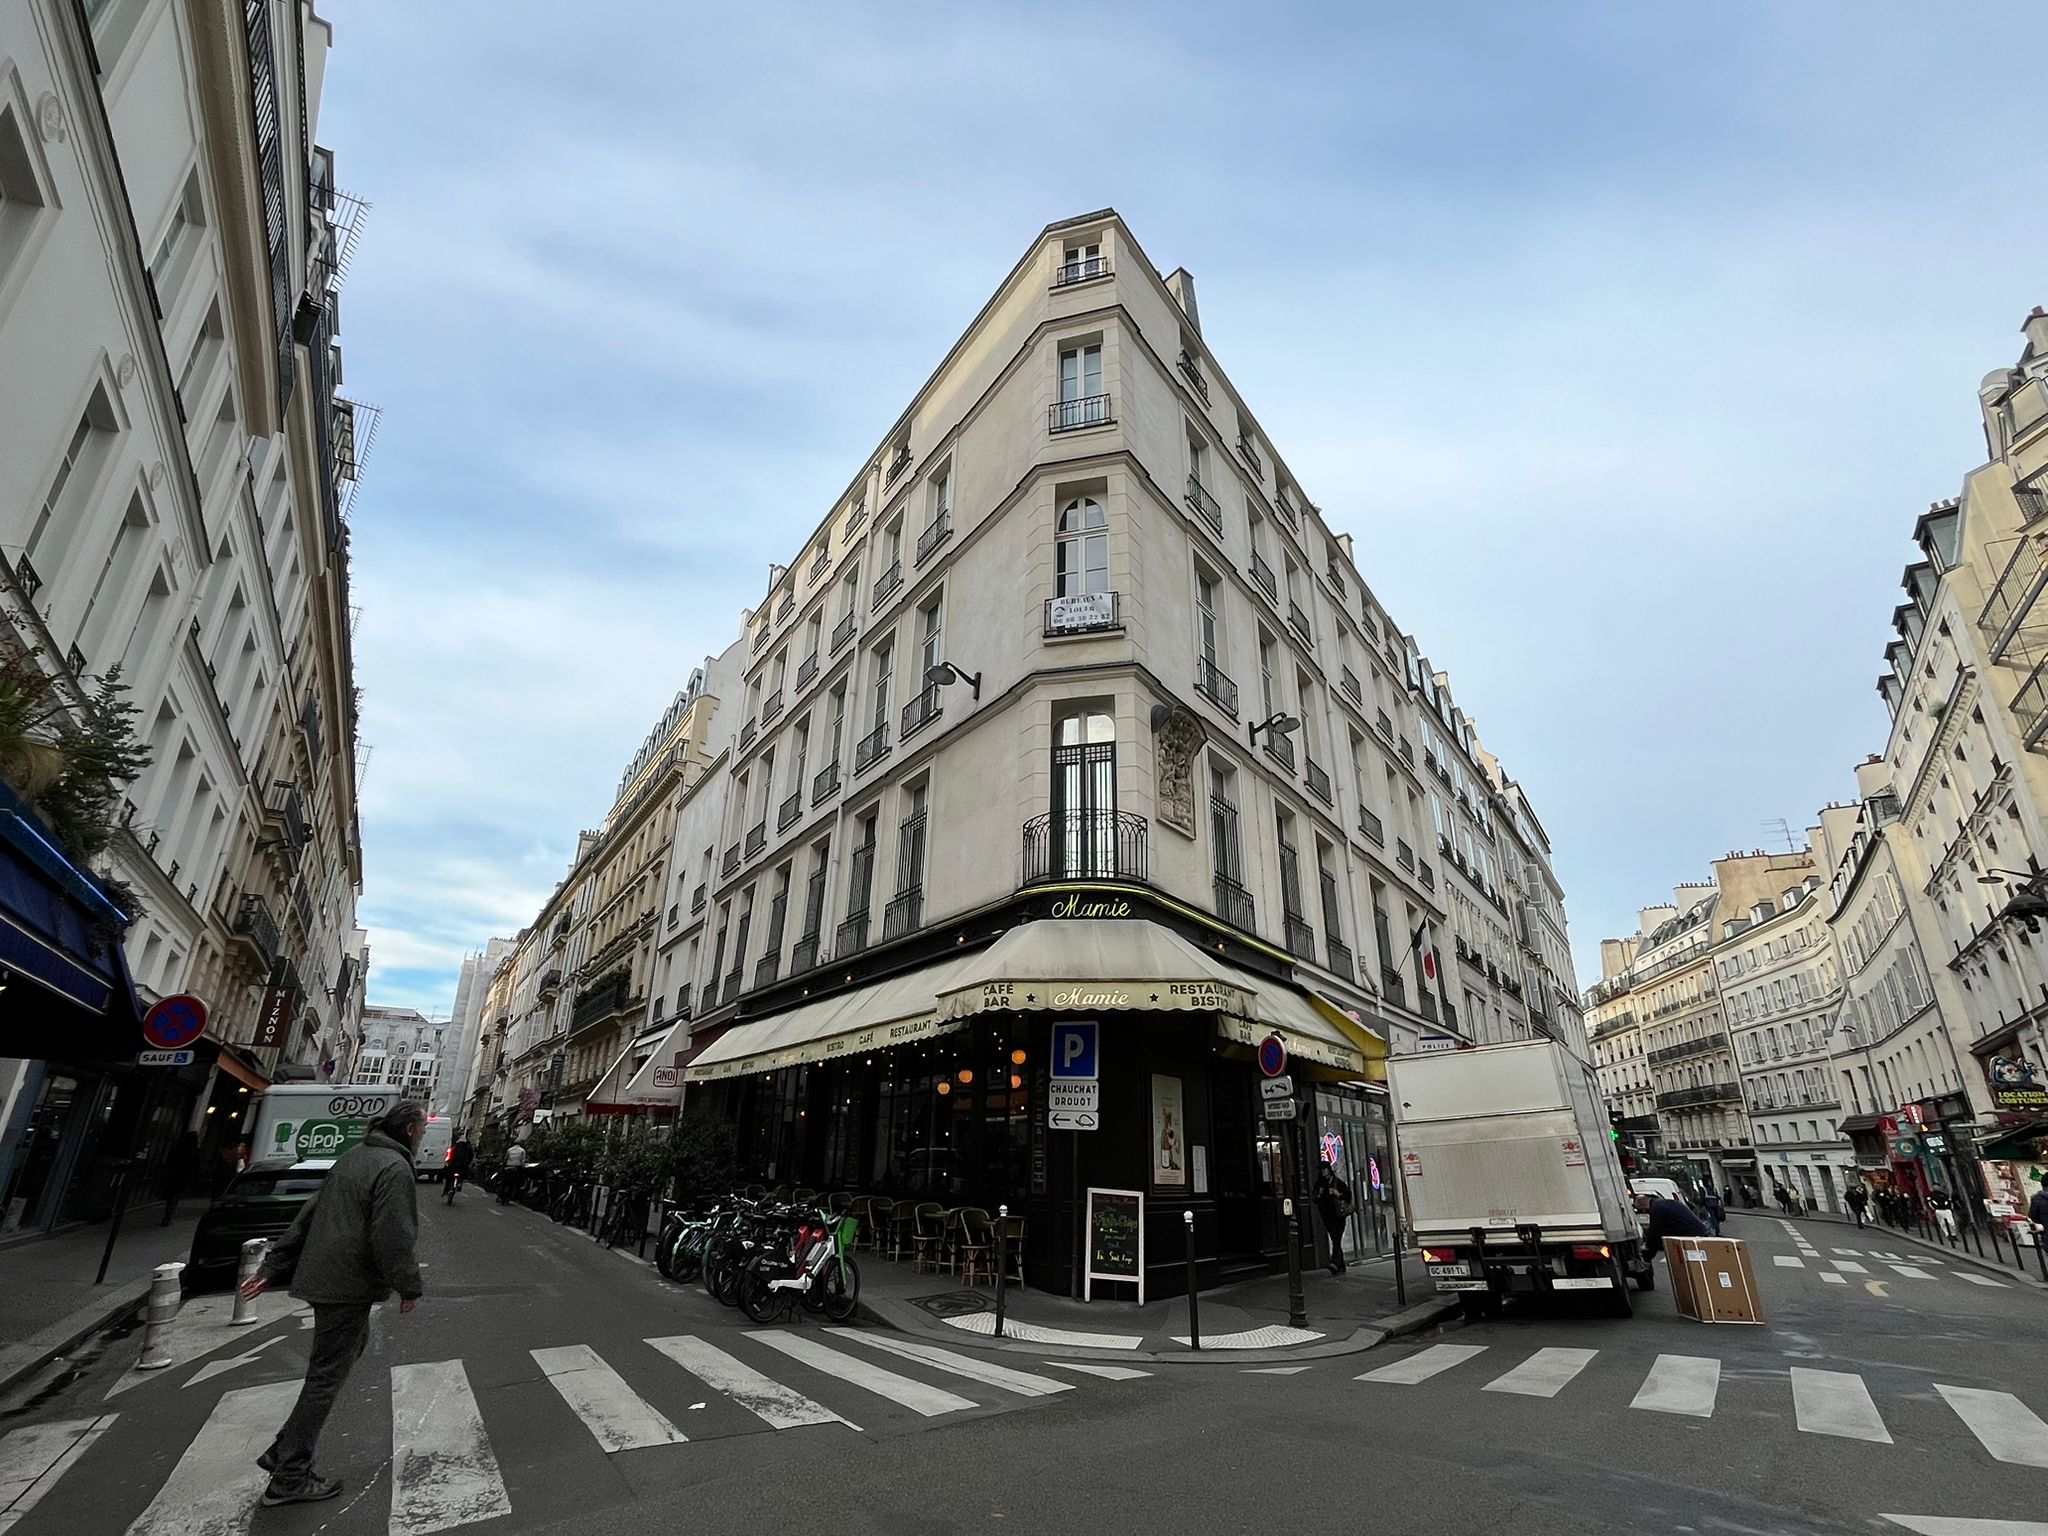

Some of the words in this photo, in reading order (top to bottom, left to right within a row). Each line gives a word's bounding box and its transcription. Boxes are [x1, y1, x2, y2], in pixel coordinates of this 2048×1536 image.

[1051, 893, 1131, 918] Mamie
[983, 982, 1014, 996] CAFÉ
[1054, 987, 1130, 1006] Mamie
[983, 996, 1010, 1008] BAR
[263, 990, 287, 1043] MIZNON
[889, 1020, 932, 1039] RESTAURANT
[143, 1054, 174, 1062] SAUF
[1064, 1033, 1085, 1068] P
[1051, 1085, 1096, 1093] CHAUCHAT
[1055, 1097, 1091, 1106] DROUOT
